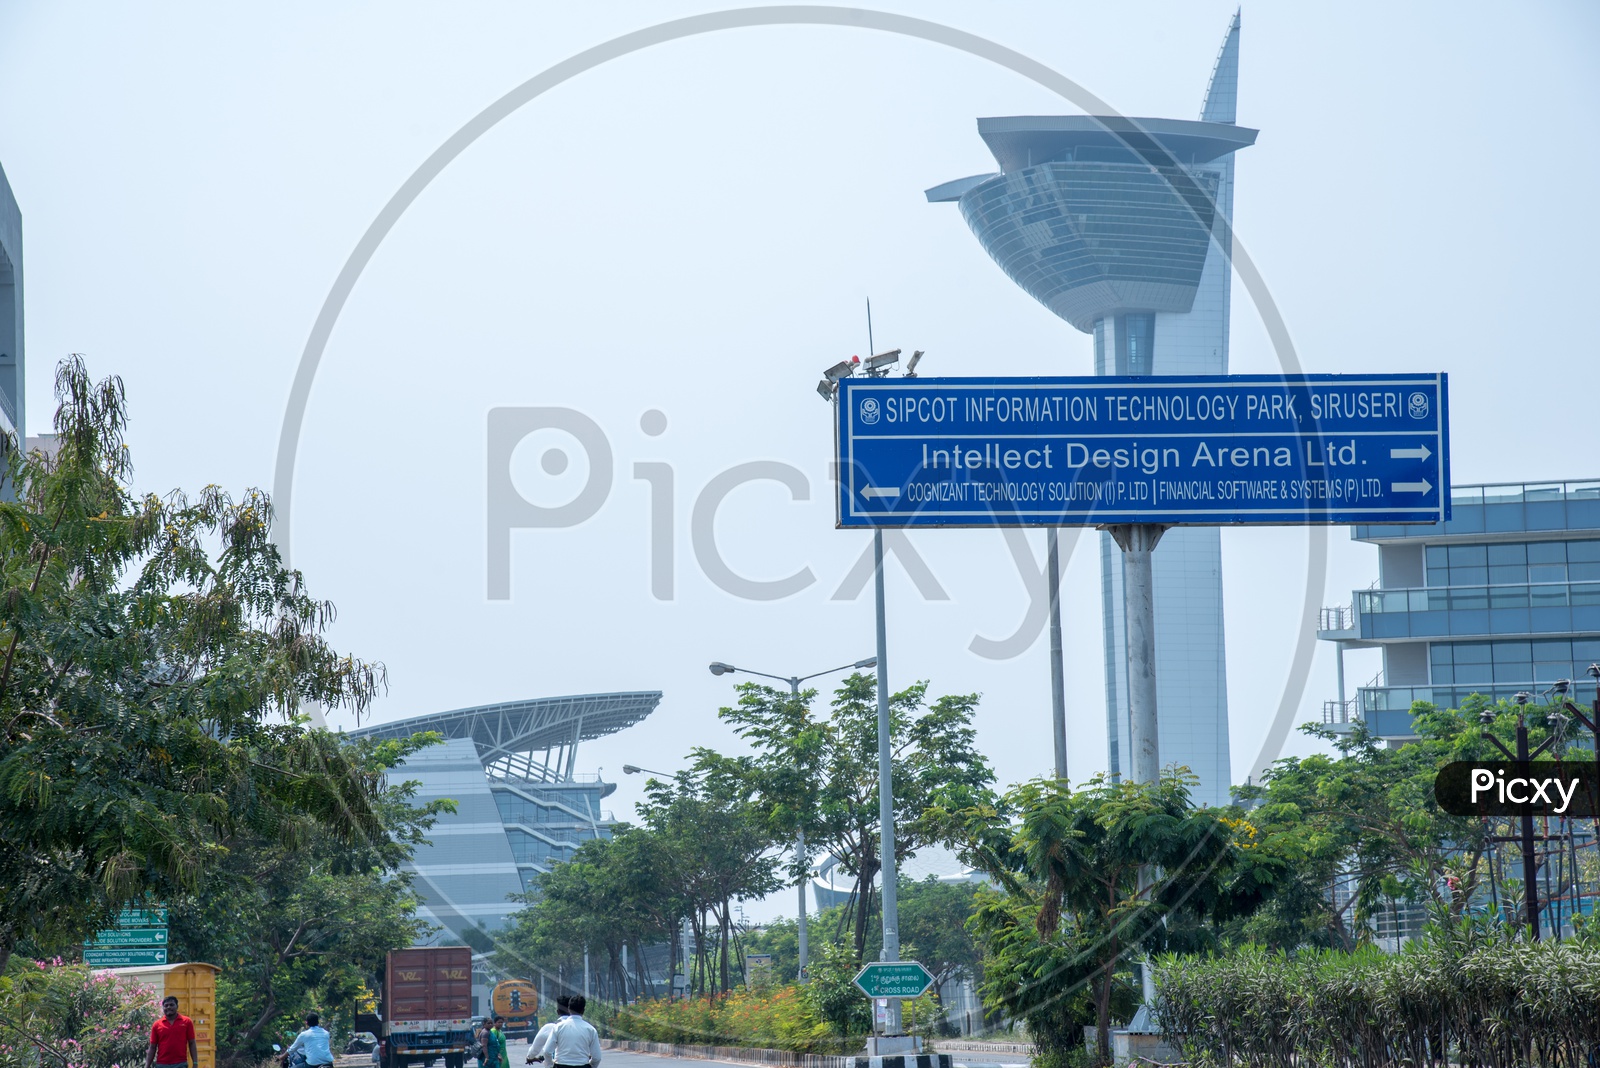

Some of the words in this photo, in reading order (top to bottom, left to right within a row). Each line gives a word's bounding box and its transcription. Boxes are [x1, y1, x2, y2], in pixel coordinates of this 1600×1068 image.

[886, 397, 958, 423] SIPCOT
[965, 396, 1097, 422] INFORMATION
[1104, 395, 1239, 421] TECHNOLOGY
[1246, 395, 1302, 424] PARK,
[1310, 392, 1403, 419] SIRUSERI
[922, 443, 1053, 469] Intellect
[1066, 442, 1180, 475] Design
[1191, 441, 1292, 467] Arena
[1306, 439, 1368, 466] Ltd.
[907, 482, 969, 502] COGNIZANT
[971, 482, 1046, 502] TECHNOLOGY
[1048, 481, 1102, 501] SOLUTION
[1129, 481, 1148, 500] LTD
[1159, 480, 1215, 500] FINANCIAL
[1217, 480, 1277, 500] SOFTWARE
[1280, 480, 1288, 499] &
[1290, 479, 1342, 499] SYSTEMS
[1361, 479, 1384, 498] LTD.
[880, 986, 901, 994] CROSS
[901, 986, 920, 994] ROAD
